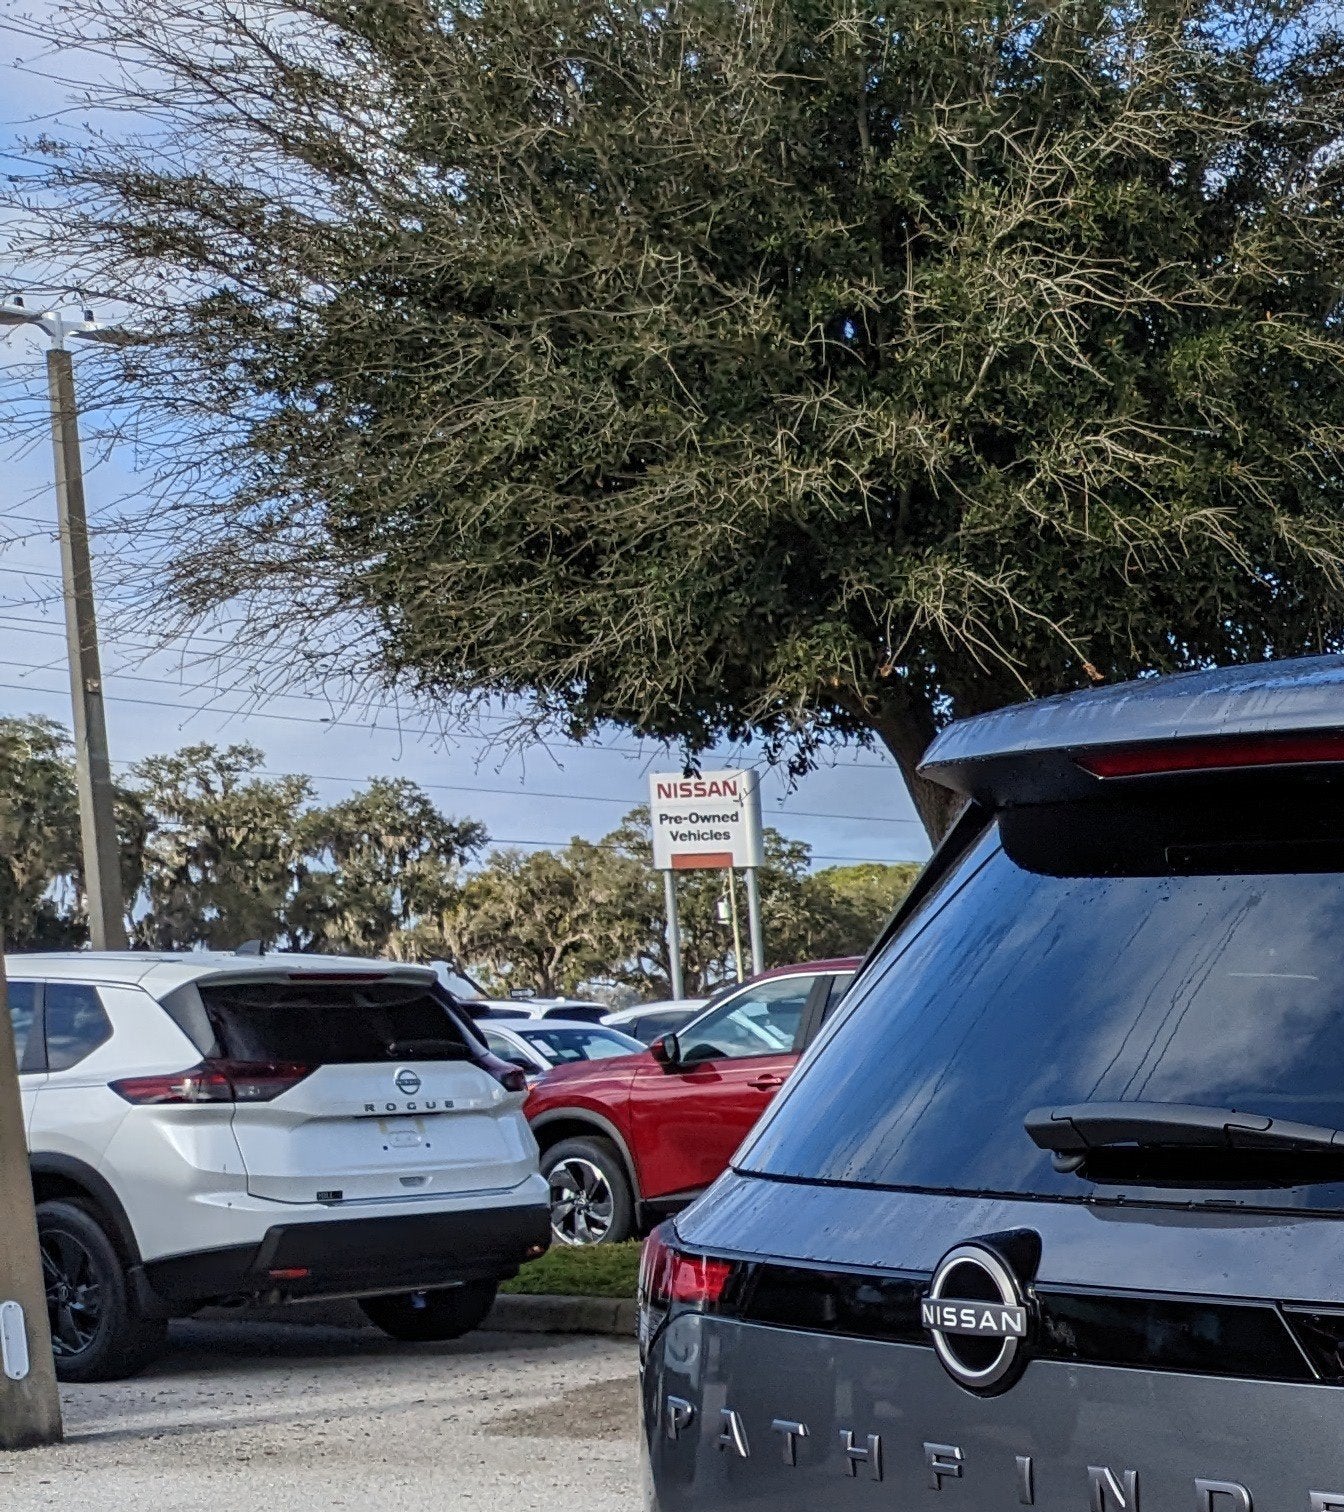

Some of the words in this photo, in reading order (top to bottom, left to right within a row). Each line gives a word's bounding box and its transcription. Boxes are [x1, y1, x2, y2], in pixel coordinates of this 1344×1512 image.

[657, 780, 737, 799] NISSAN
[659, 811, 739, 825] Pre-Owned
[669, 829, 731, 842] Vehicles
[364, 1100, 454, 1112] ROGUE
[922, 1304, 1022, 1332] NISSAN
